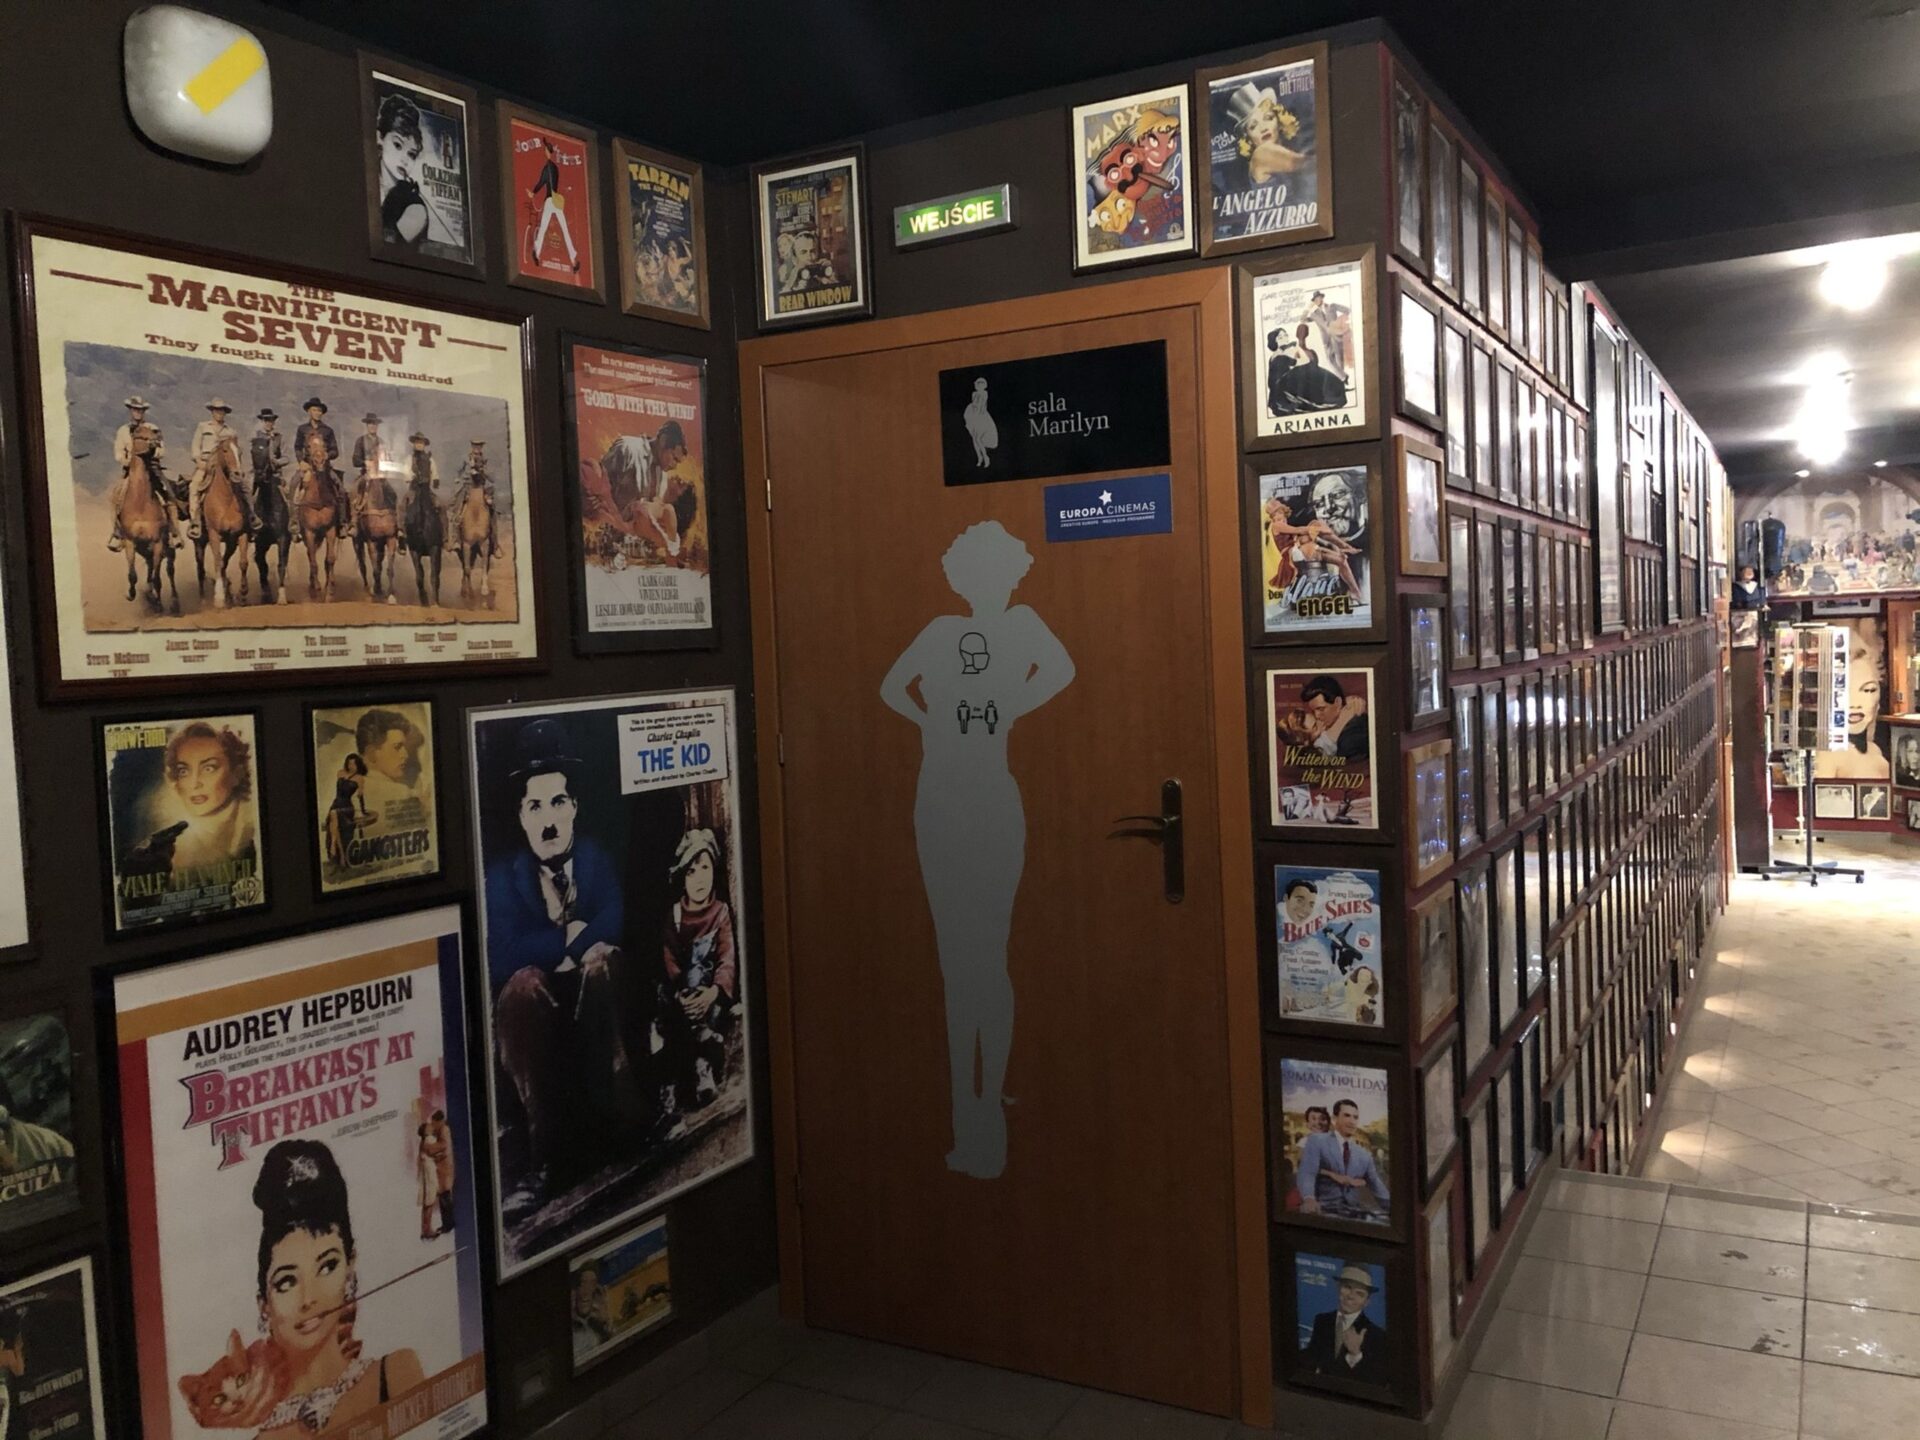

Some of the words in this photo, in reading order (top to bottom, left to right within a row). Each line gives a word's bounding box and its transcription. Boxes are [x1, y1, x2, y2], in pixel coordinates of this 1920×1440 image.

[1087, 104, 1142, 158] MARX
[515, 138, 541, 152] JOUR
[628, 163, 690, 201] TARZAN
[775, 187, 814, 206] STEWART
[909, 200, 995, 234] WEJŚCIE
[1244, 202, 1317, 235] AZZURRO
[288, 283, 335, 302] THE
[779, 293, 805, 312] REAR
[806, 286, 852, 307] WINDOW
[147, 273, 442, 348] MAGNIFICENT
[223, 311, 405, 364] SEVEN
[145, 333, 199, 351] They
[211, 343, 274, 360] fought
[285, 354, 320, 367] like
[330, 362, 377, 375] seven
[387, 368, 453, 385] hundred
[615, 394, 645, 413] WITH
[644, 399, 667, 416] THE
[1028, 392, 1067, 415] sala
[1028, 412, 1110, 437] Marilyn
[1274, 413, 1351, 435] ARIANNA
[1060, 507, 1103, 519] EUROPA
[1107, 501, 1156, 515] CINEMAS
[1298, 596, 1353, 617] ENGEL
[86, 654, 110, 665] STEVE
[675, 728, 701, 740] Chaplin
[637, 747, 675, 773] THE
[681, 743, 711, 767] KID
[1283, 745, 1328, 767] Written
[1330, 756, 1346, 766] on
[1302, 767, 1321, 782] the
[1320, 769, 1364, 790] WIND
[348, 829, 429, 865] GANGSTERS
[1283, 915, 1323, 942] BLUE
[1325, 898, 1372, 919] SKIES
[184, 1005, 293, 1061] AUDREY
[302, 975, 412, 1029] HEPBURN
[195, 1058, 216, 1068] PLAYS
[228, 1058, 259, 1072] BETWEEN
[262, 1053, 274, 1061] THE
[179, 1038, 380, 1129] BREAKFAST
[384, 1031, 416, 1065] AT
[1331, 1074, 1387, 1091] HOLIDAY
[211, 1072, 378, 1170] TIFFANY'S
[0, 1162, 61, 1203] CULA
